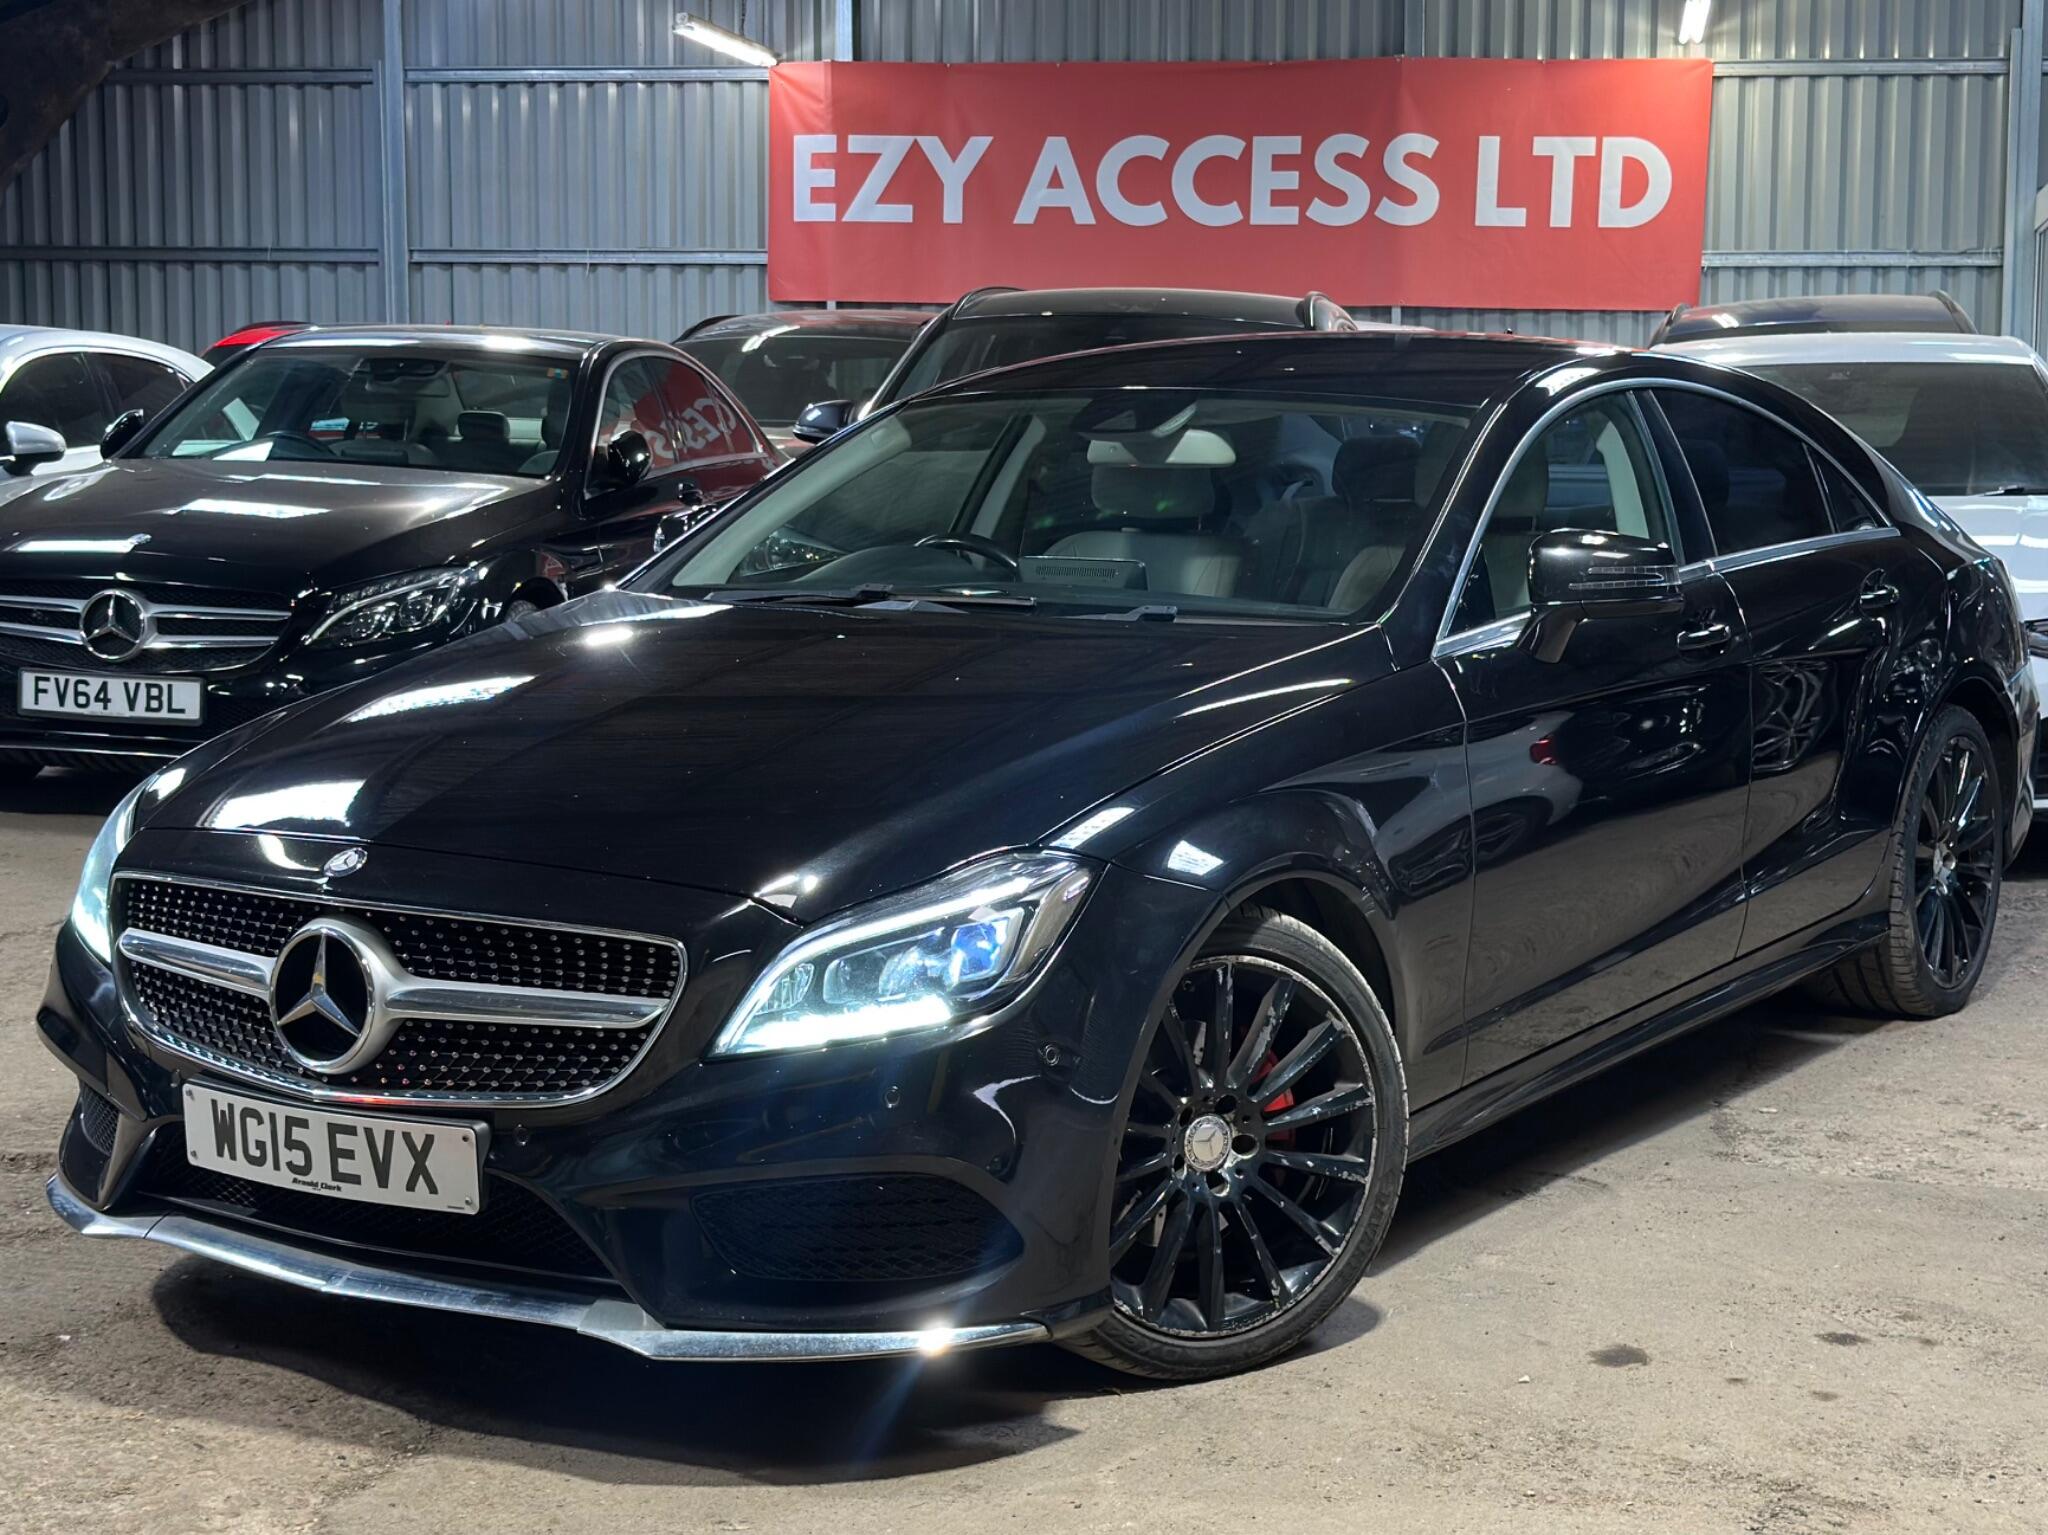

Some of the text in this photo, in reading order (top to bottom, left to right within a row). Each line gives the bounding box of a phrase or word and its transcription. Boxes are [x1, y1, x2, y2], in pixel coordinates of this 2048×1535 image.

[793, 133, 1672, 228] EZY ACCESS LTD
[33, 675, 186, 714] FV64 VBL
[210, 1098, 439, 1195] WG15 EVX
